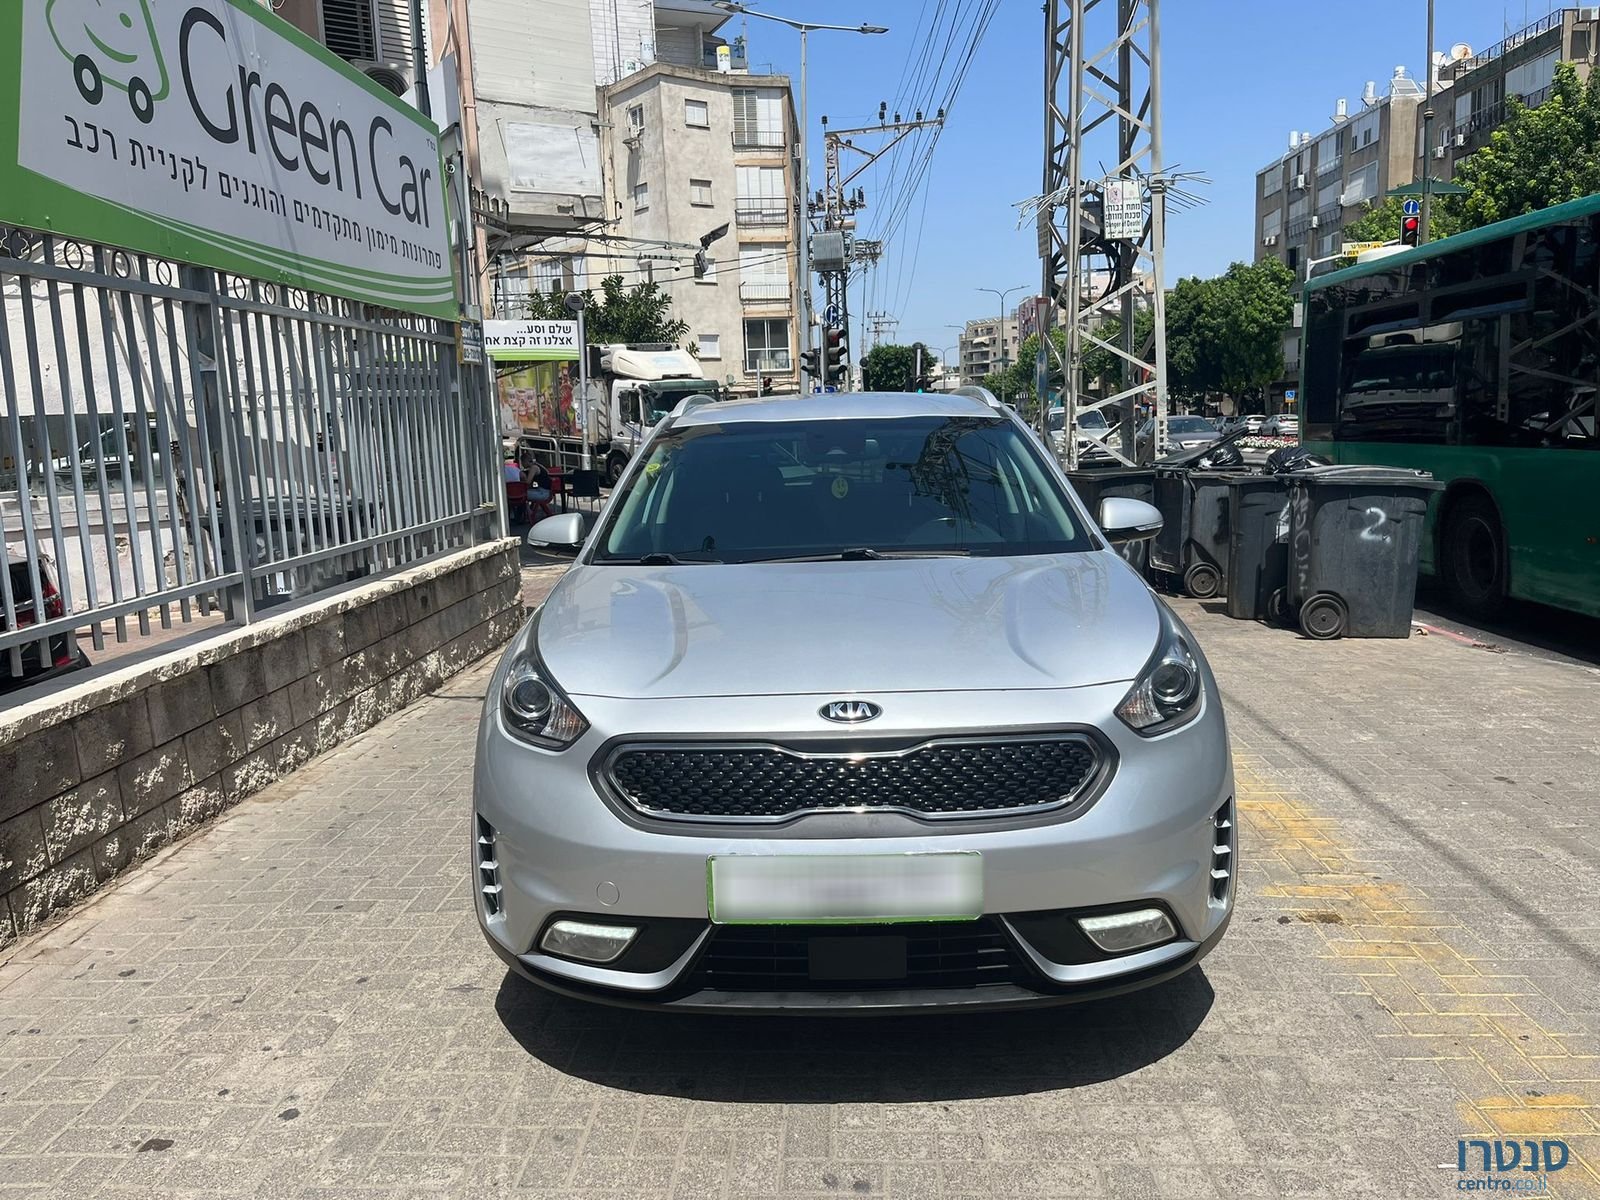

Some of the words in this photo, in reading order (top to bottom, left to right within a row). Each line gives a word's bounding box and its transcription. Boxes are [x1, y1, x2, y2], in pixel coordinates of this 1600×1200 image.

[179, 7, 362, 200] Green
[369, 115, 431, 229] Car
[64, 114, 118, 160] רכב
[128, 138, 208, 193] לקניית
[218, 171, 287, 217] והוגנים
[293, 199, 362, 243] מתקדמים
[1124, 211, 1140, 219] סכנת
[366, 226, 398, 255] מימון
[401, 239, 442, 270] פתרונות
[503, 336, 526, 348] קצת
[516, 324, 545, 334] וסע...
[529, 336, 540, 345] זה
[544, 334, 573, 346] אצלנו
[548, 323, 572, 334] שלם
[1361, 507, 1391, 543] 2
[829, 702, 873, 718] KIA
